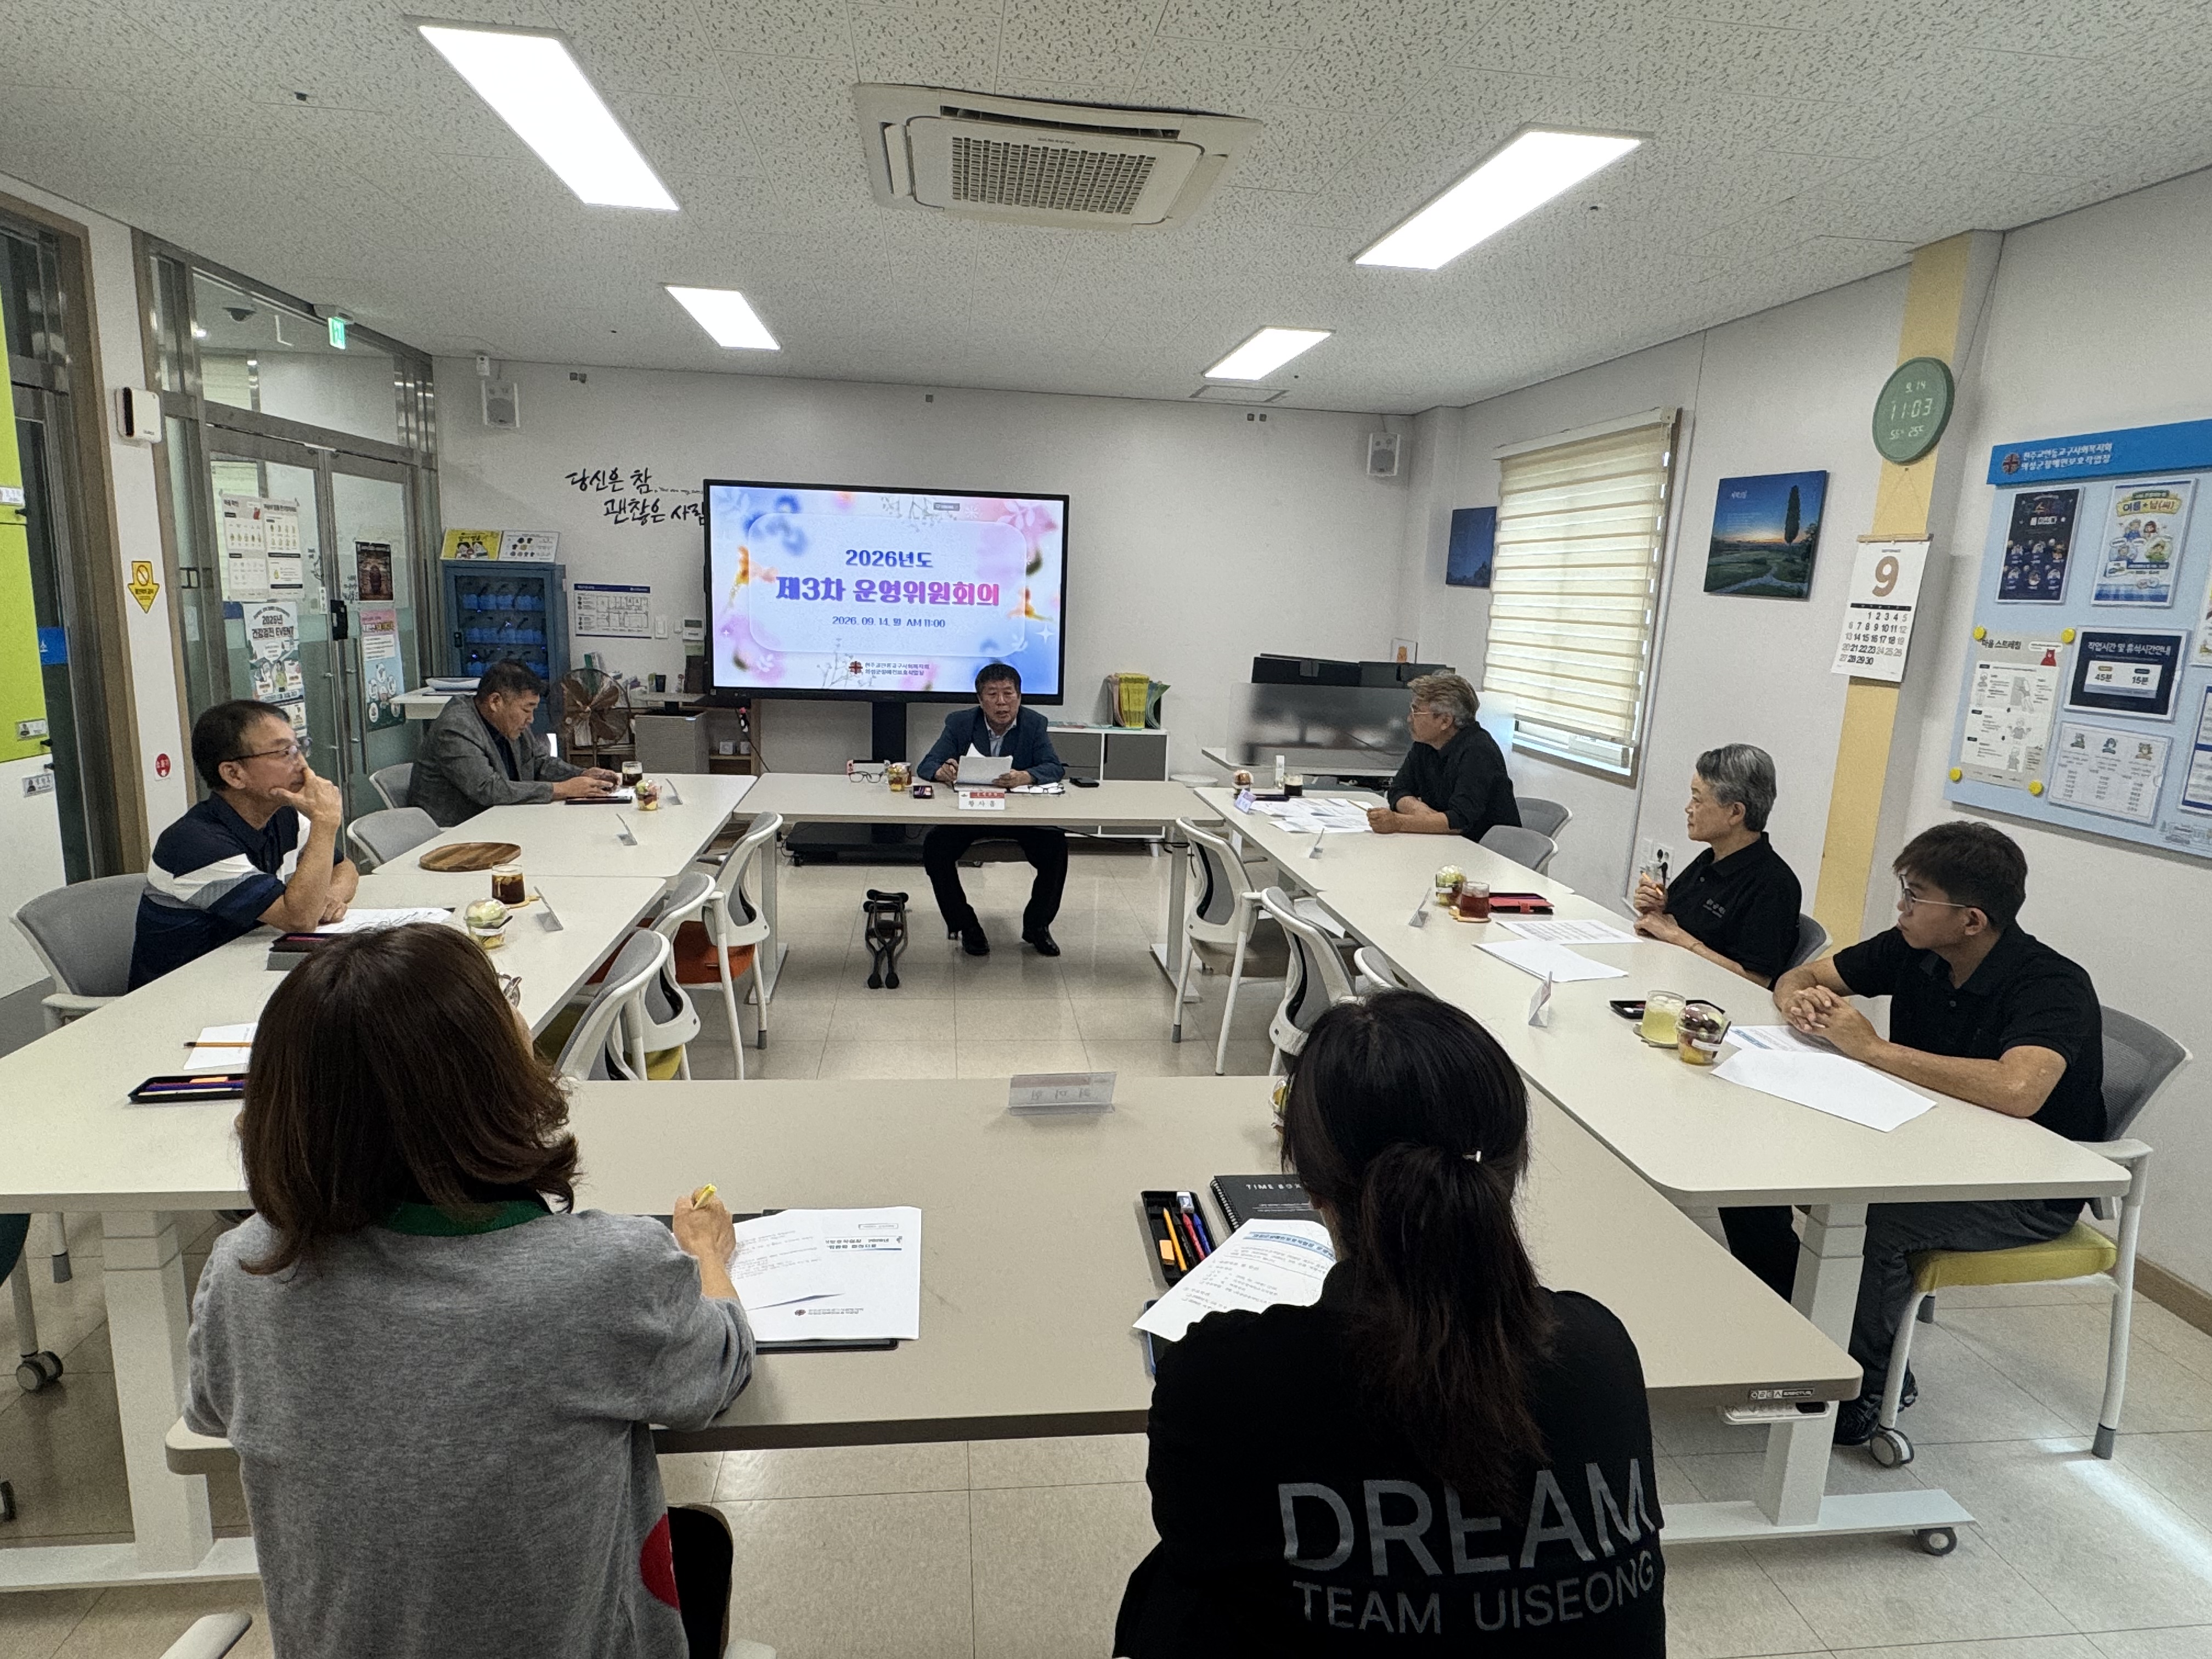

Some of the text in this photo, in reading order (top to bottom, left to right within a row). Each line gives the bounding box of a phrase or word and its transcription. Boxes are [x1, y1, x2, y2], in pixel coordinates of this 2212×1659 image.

[565, 467, 653, 494] 당신은 참
[603, 498, 665, 526] 괜찮은
[845, 549, 933, 568] 2026년도
[1872, 555, 1899, 597] 9
[776, 576, 1000, 606] 제3차 운영위원회의
[906, 619, 922, 627] AM
[924, 619, 946, 628] 11:00
[1865, 623, 1870, 631] 8
[1874, 623, 1878, 631] 9
[1882, 624, 1889, 632] 10
[1891, 625, 1897, 633] 11
[1854, 633, 1861, 641] 14
[1862, 634, 1870, 642] 15
[1871, 634, 1878, 643] 16
[1880, 635, 1887, 644] 17
[1888, 636, 1895, 644] 18
[1858, 644, 1867, 653] 22
[1867, 645, 1876, 654] 23
[1995, 640, 2022, 650] 스트레칭
[2088, 642, 2116, 652] 작업시간
[1856, 656, 1865, 664] 29
[1865, 657, 1874, 665] 30
[2095, 674, 2112, 682] 45분
[2132, 676, 2148, 685] 15분
[1278, 1458, 1656, 1577] DREAM
[1293, 1550, 1656, 1634] TEAM UISEONG
